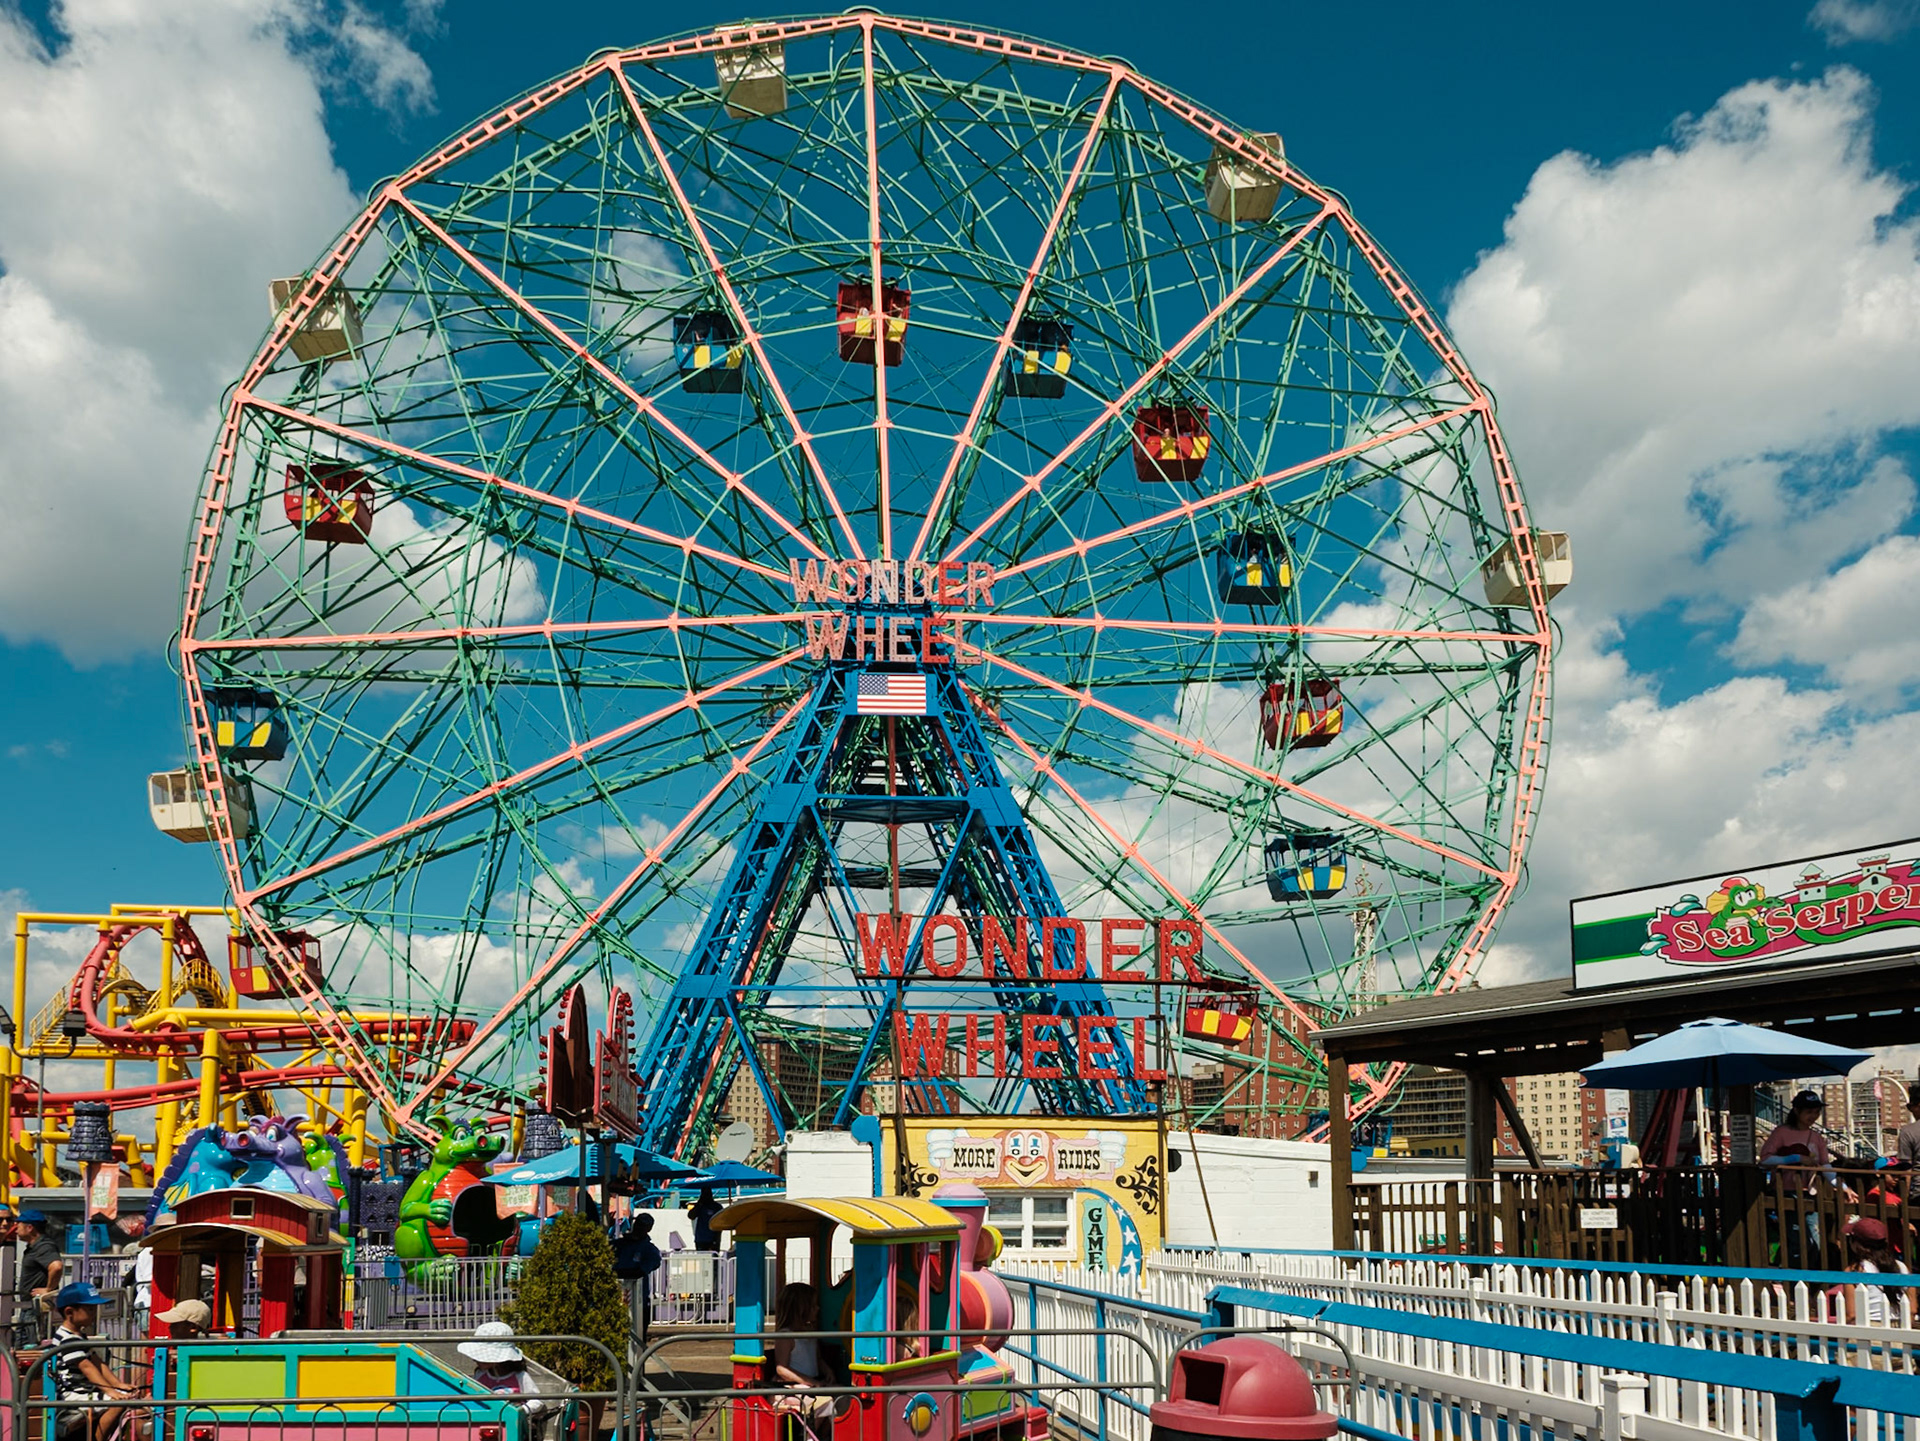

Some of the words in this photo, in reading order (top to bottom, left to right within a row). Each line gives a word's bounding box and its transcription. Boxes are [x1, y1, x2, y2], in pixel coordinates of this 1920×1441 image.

[789, 558, 995, 606] WONDER
[804, 614, 983, 665] WHEEL
[856, 912, 1205, 983] WONDER
[1672, 919, 1754, 953] Sea
[893, 1011, 1168, 1081] WHEEL
[953, 1147, 996, 1169] MORE
[1057, 1147, 1101, 1171] RIDES
